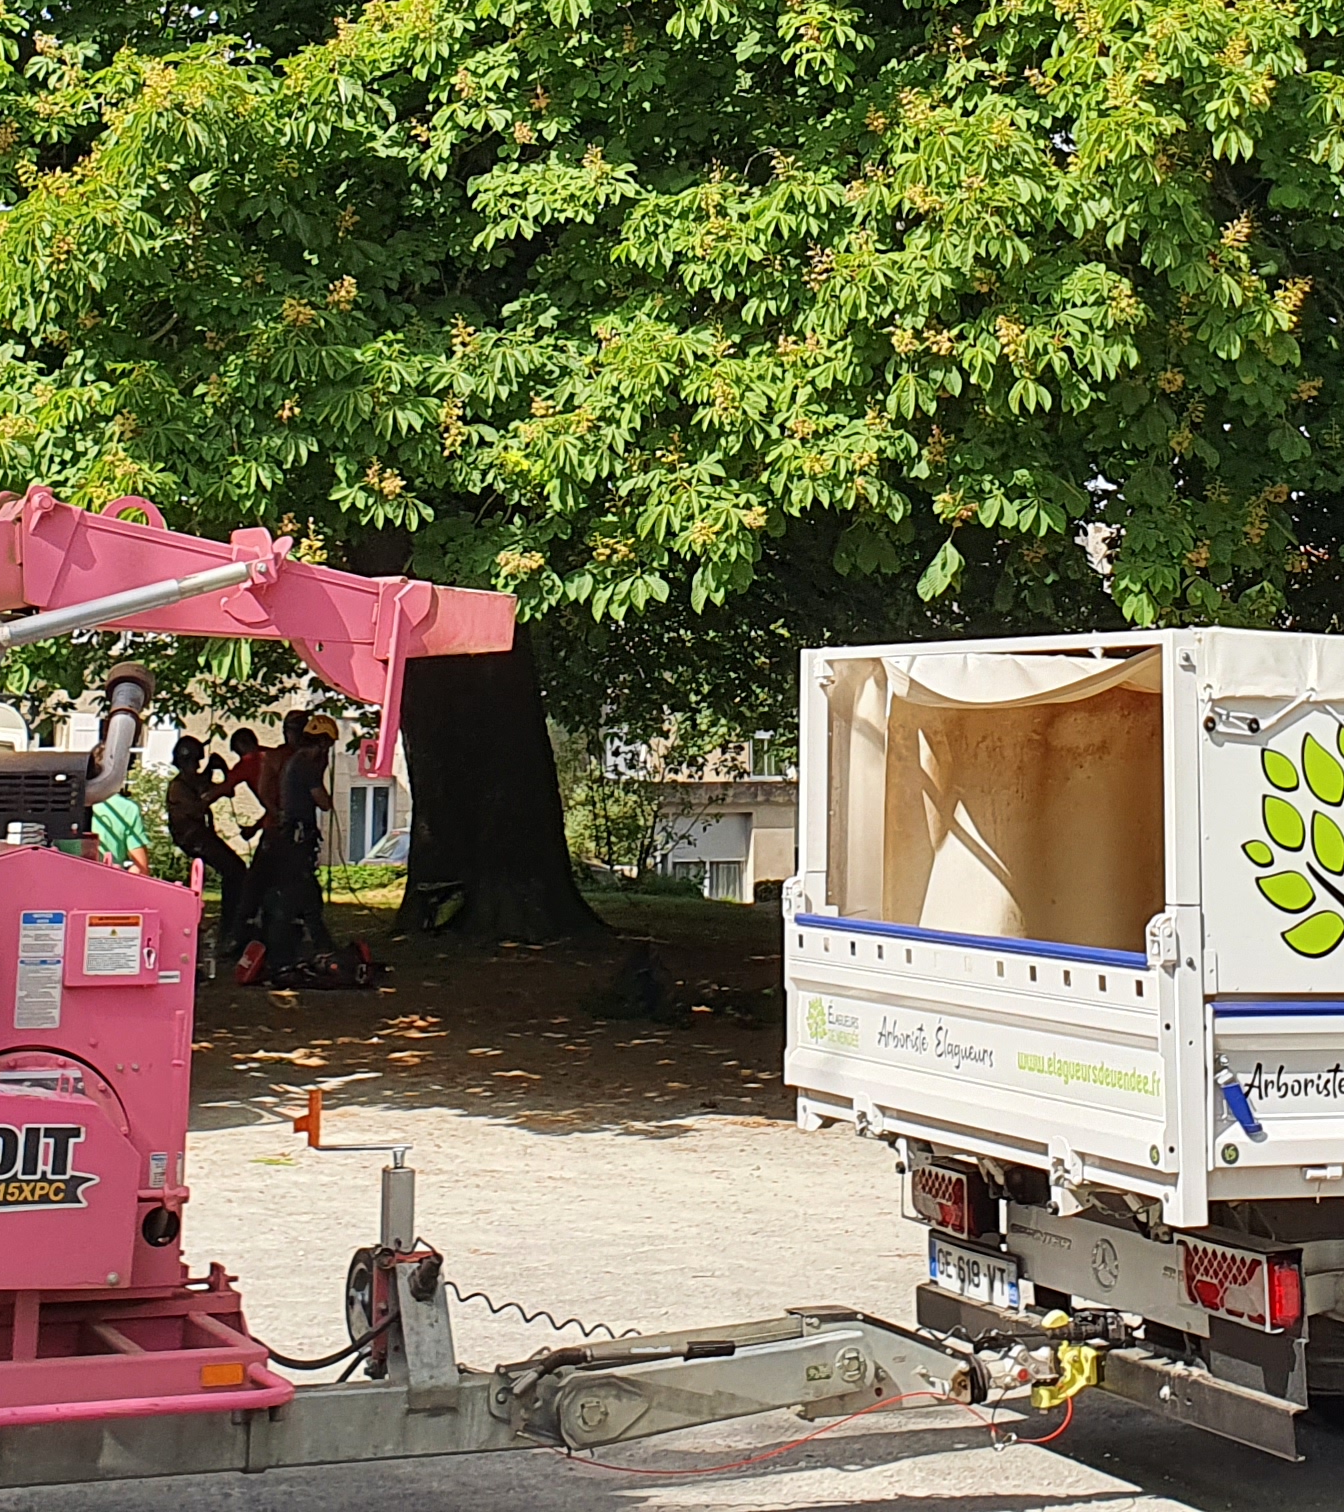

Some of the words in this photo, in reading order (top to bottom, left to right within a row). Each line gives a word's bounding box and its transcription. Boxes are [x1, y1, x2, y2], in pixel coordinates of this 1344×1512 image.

[877, 1014, 929, 1052] Arboriste
[933, 1017, 994, 1069] Élagueurs
[1017, 1050, 1161, 1097] www.elagueursdevendee.fr
[937, 1247, 1006, 1296] GE-619-VT
